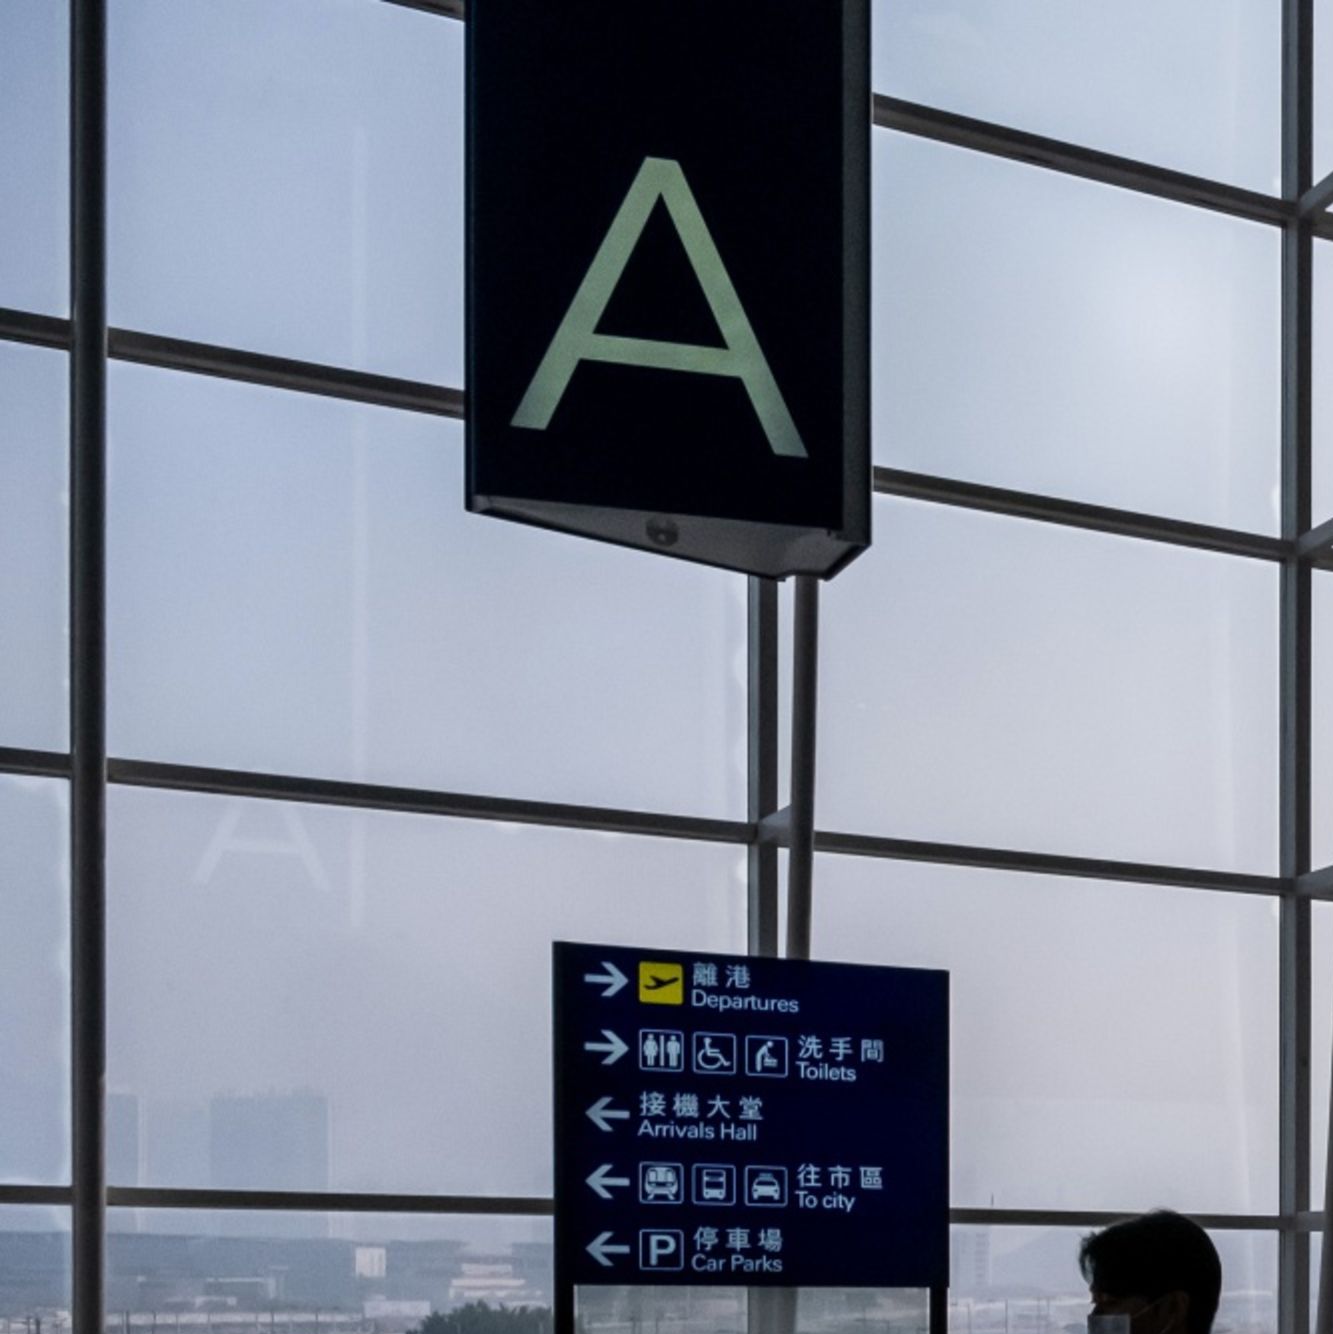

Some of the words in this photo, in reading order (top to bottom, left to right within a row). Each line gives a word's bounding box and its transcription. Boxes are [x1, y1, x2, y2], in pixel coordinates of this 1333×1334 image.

[511, 156, 807, 457] A
[692, 961, 751, 989] 離港
[691, 988, 799, 1013] Departures
[797, 1034, 885, 1063] 洗手間
[795, 1061, 857, 1082] Toilets
[639, 1090, 764, 1121] 接機大堂
[637, 1119, 715, 1139] Arrivals
[720, 1122, 758, 1141] Hall
[796, 1163, 883, 1190] 往市區
[794, 1190, 818, 1209] To
[822, 1191, 856, 1213] city
[693, 1226, 783, 1253] 停車場
[691, 1253, 726, 1272] Car
[731, 1254, 783, 1273] Parks
